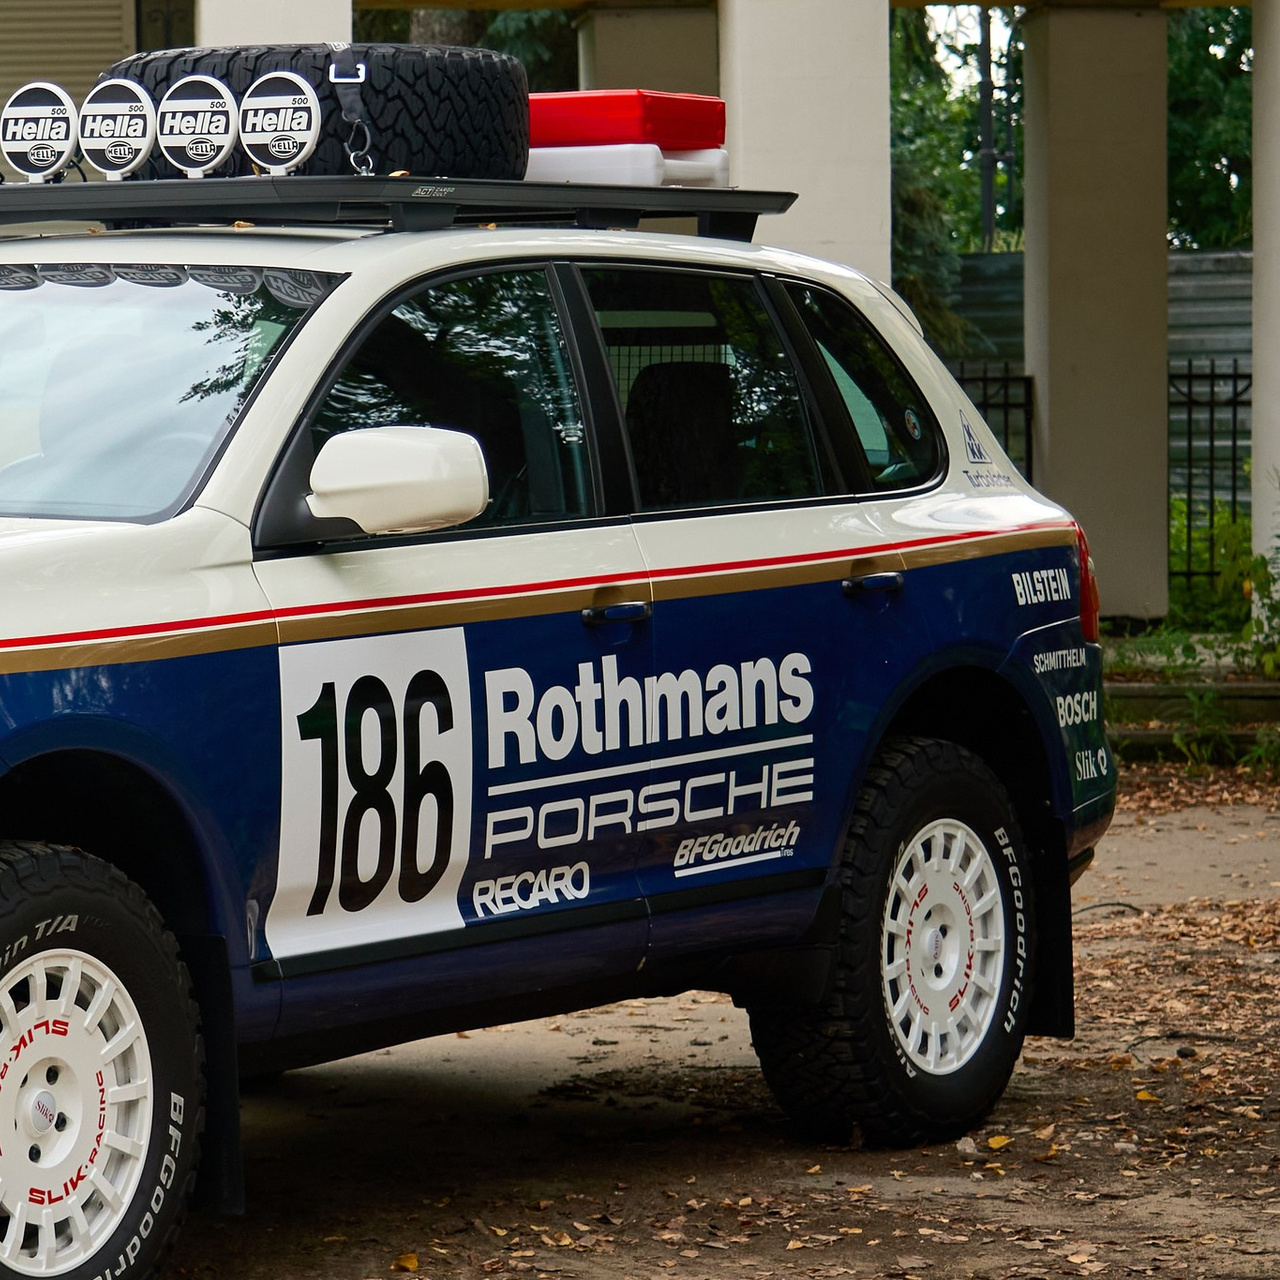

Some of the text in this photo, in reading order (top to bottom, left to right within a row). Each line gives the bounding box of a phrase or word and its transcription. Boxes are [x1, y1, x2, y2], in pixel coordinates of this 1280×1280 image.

[50, 107, 67, 116] 500
[128, 104, 145, 113] 500
[209, 101, 227, 109] 500
[291, 97, 309, 106] 500
[5, 118, 68, 141] Hella
[83, 115, 145, 138] Hella
[162, 112, 227, 135] Hella
[244, 108, 309, 132] Hella
[30, 149, 57, 160] HELLA
[107, 146, 134, 157] HELLA
[188, 143, 217, 154] HELLA
[271, 140, 299, 152] HELLA
[1011, 568, 1071, 606] BILSTEIN
[1033, 647, 1087, 674] SCHMITTHELM
[485, 652, 815, 769] Rothmans
[1056, 690, 1098, 728] BOSCH
[1075, 750, 1098, 781] Slik
[296, 669, 454, 916] 186
[484, 757, 815, 859] PORSCHE
[673, 820, 801, 868] BFGoodrich
[780, 847, 794, 857] Tires
[472, 860, 590, 918] RECARO
[35, 914, 79, 941] T/A
[993, 826, 1027, 1034] BFGoodrich
[10, 1019, 69, 1062] SLIK
[28, 1164, 88, 1205] SLIK
